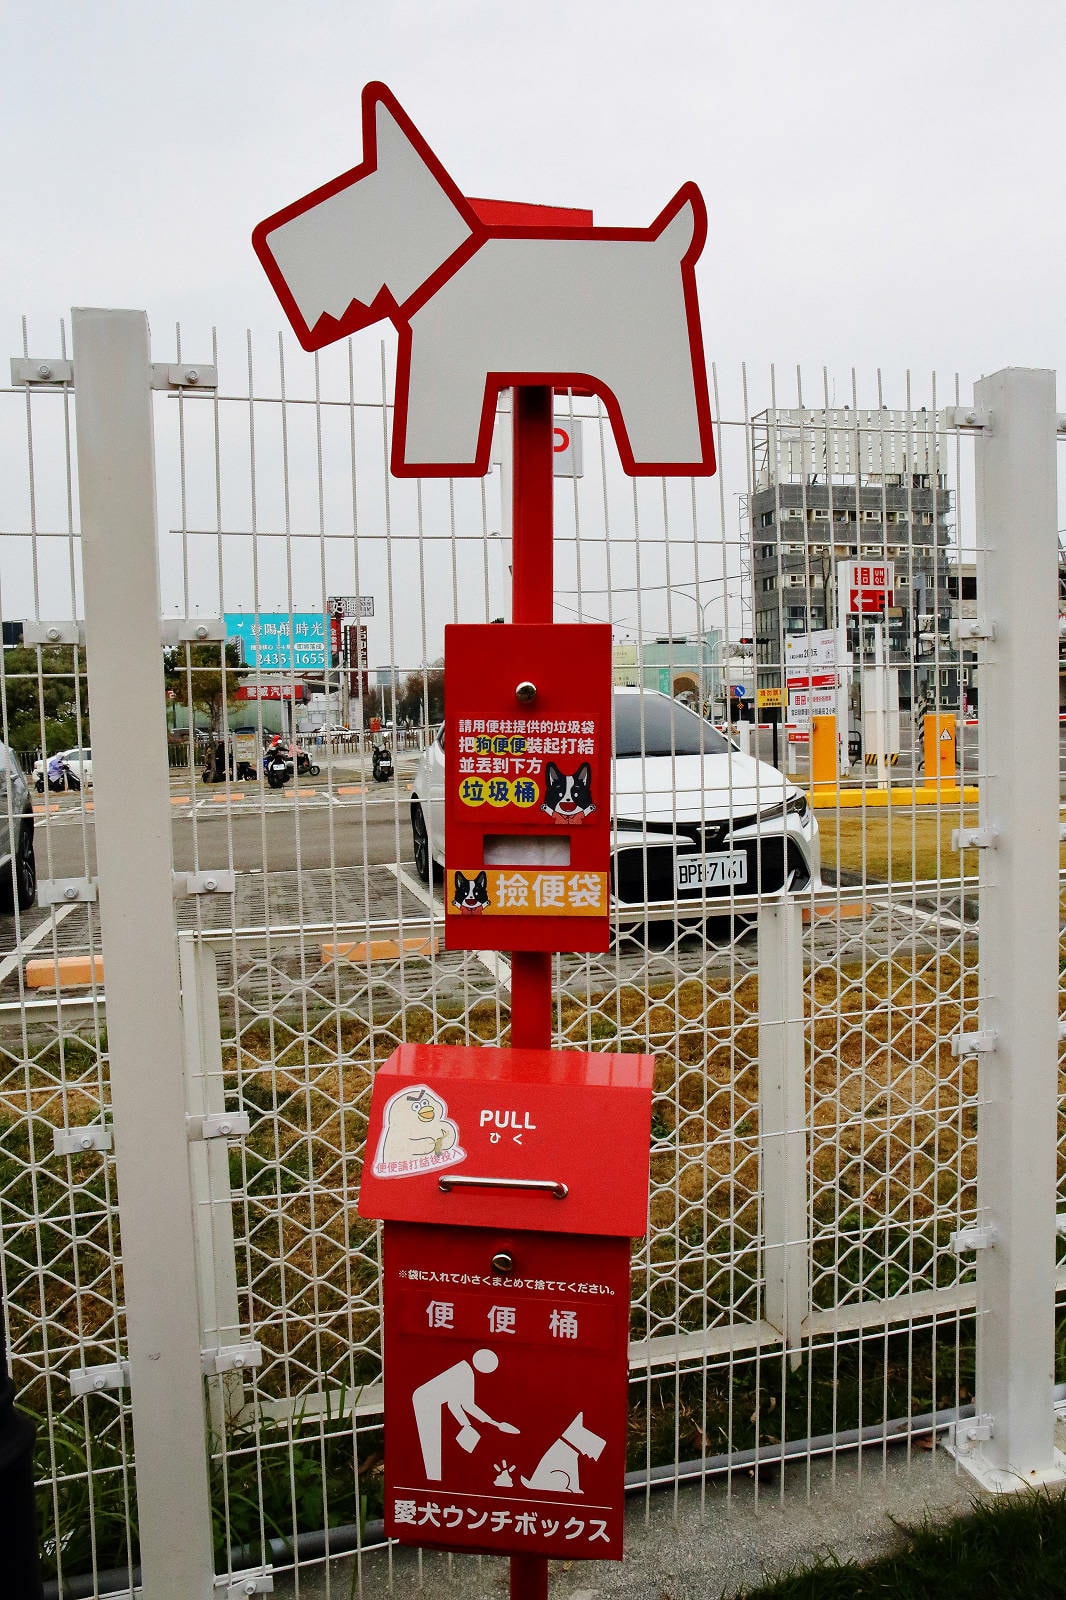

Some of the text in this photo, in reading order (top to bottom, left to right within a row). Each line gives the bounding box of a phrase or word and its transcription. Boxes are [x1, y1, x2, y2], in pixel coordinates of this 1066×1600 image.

[458, 719, 595, 735] 請用便柱提供的垃圾袋
[458, 736, 595, 755] 把狗便便裝起打結
[458, 757, 543, 775] 並丟到下方
[462, 780, 536, 803] 垃圾桶
[496, 873, 602, 908] 撿便袋
[479, 1110, 537, 1130] PULL
[375, 1148, 464, 1175] 便便請打結後投入
[425, 1300, 579, 1340] 便便桶
[393, 1499, 612, 1543] 愛犬ウンチボックス
